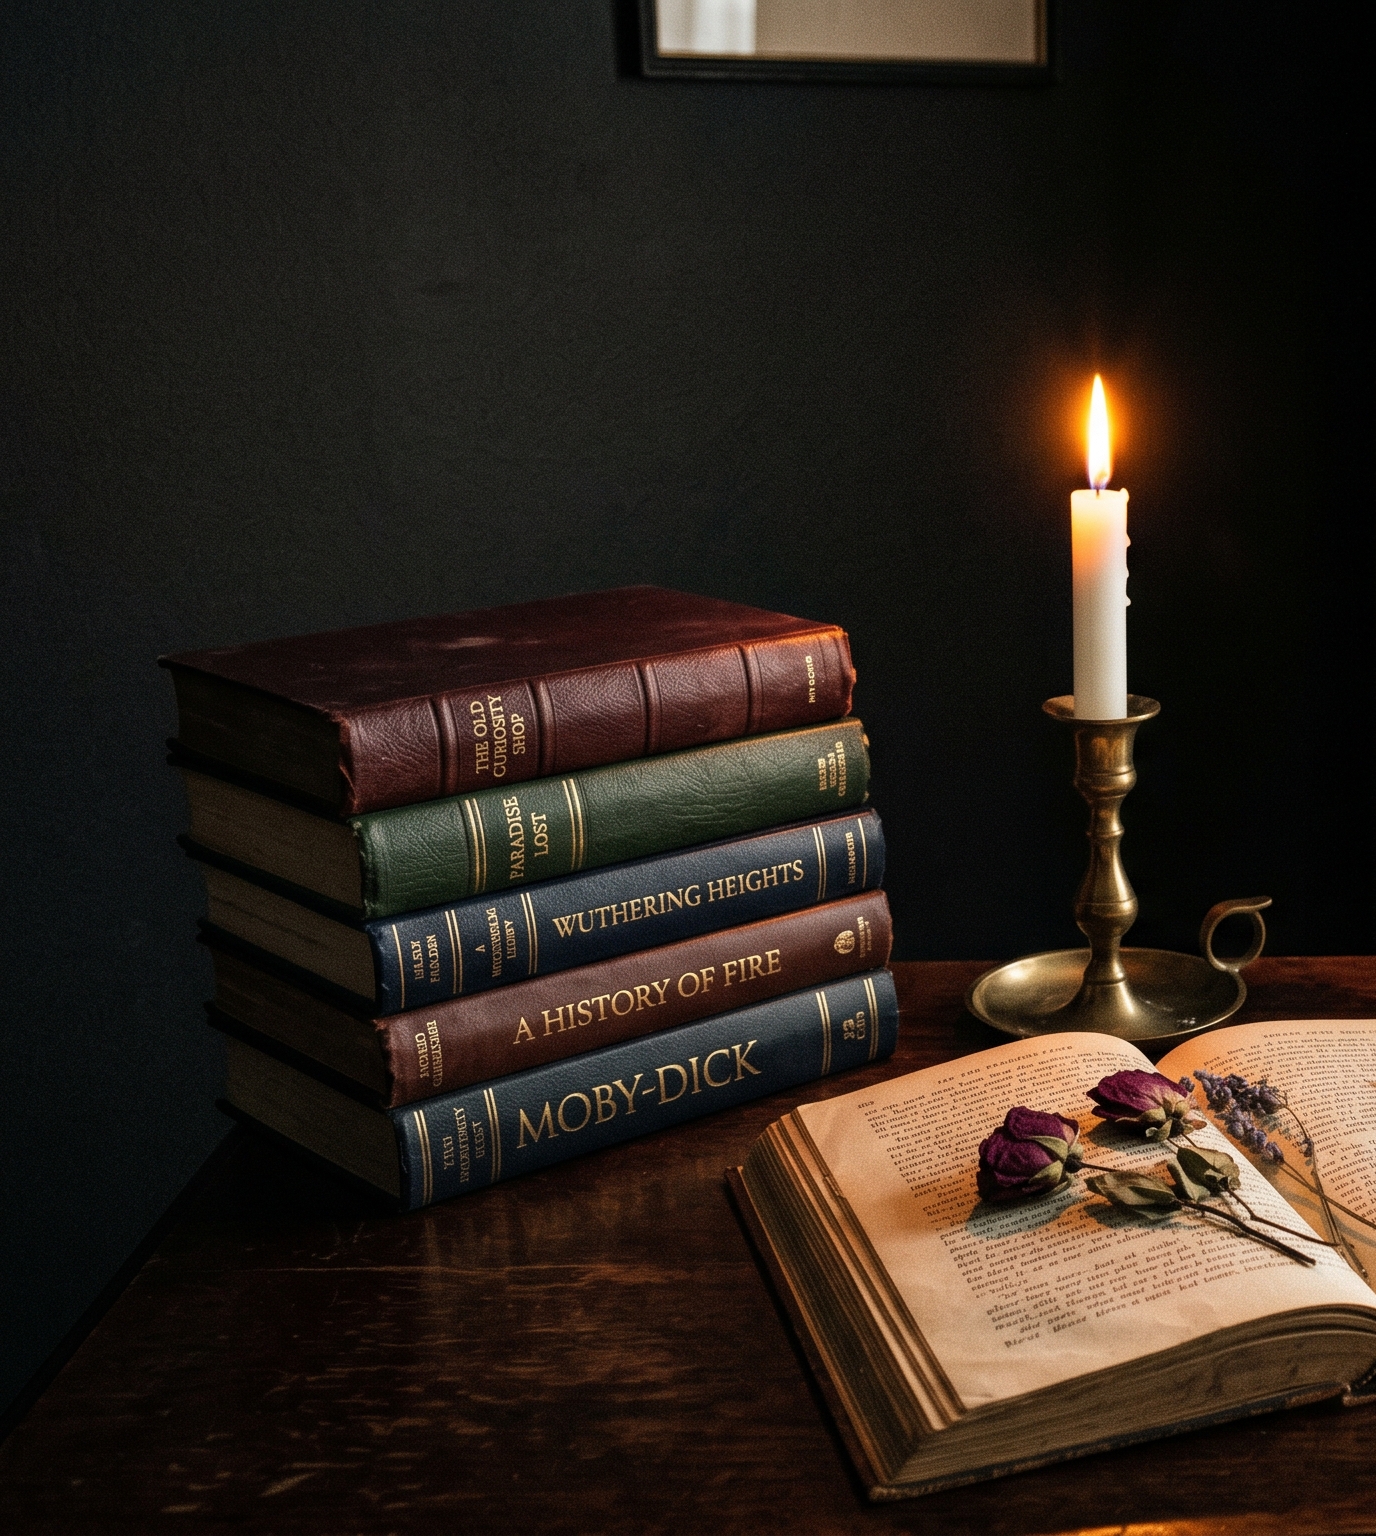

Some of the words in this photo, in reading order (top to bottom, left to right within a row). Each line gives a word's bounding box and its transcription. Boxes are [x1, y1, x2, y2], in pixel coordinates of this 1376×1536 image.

[470, 701, 487, 737] OLD
[475, 740, 489, 774] THE
[487, 694, 507, 778] CURIOSITY
[510, 713, 526, 755] SHOP
[503, 796, 524, 879] PARADISE
[530, 812, 549, 858] LOST
[552, 884, 701, 938] WUTHERING
[707, 859, 805, 902] HEIGHTS
[512, 1016, 536, 1045] A
[541, 978, 671, 1036] HISTORY
[677, 966, 715, 998] OF
[722, 949, 782, 987] FIRE
[516, 1039, 762, 1149] MOBY-DICK
